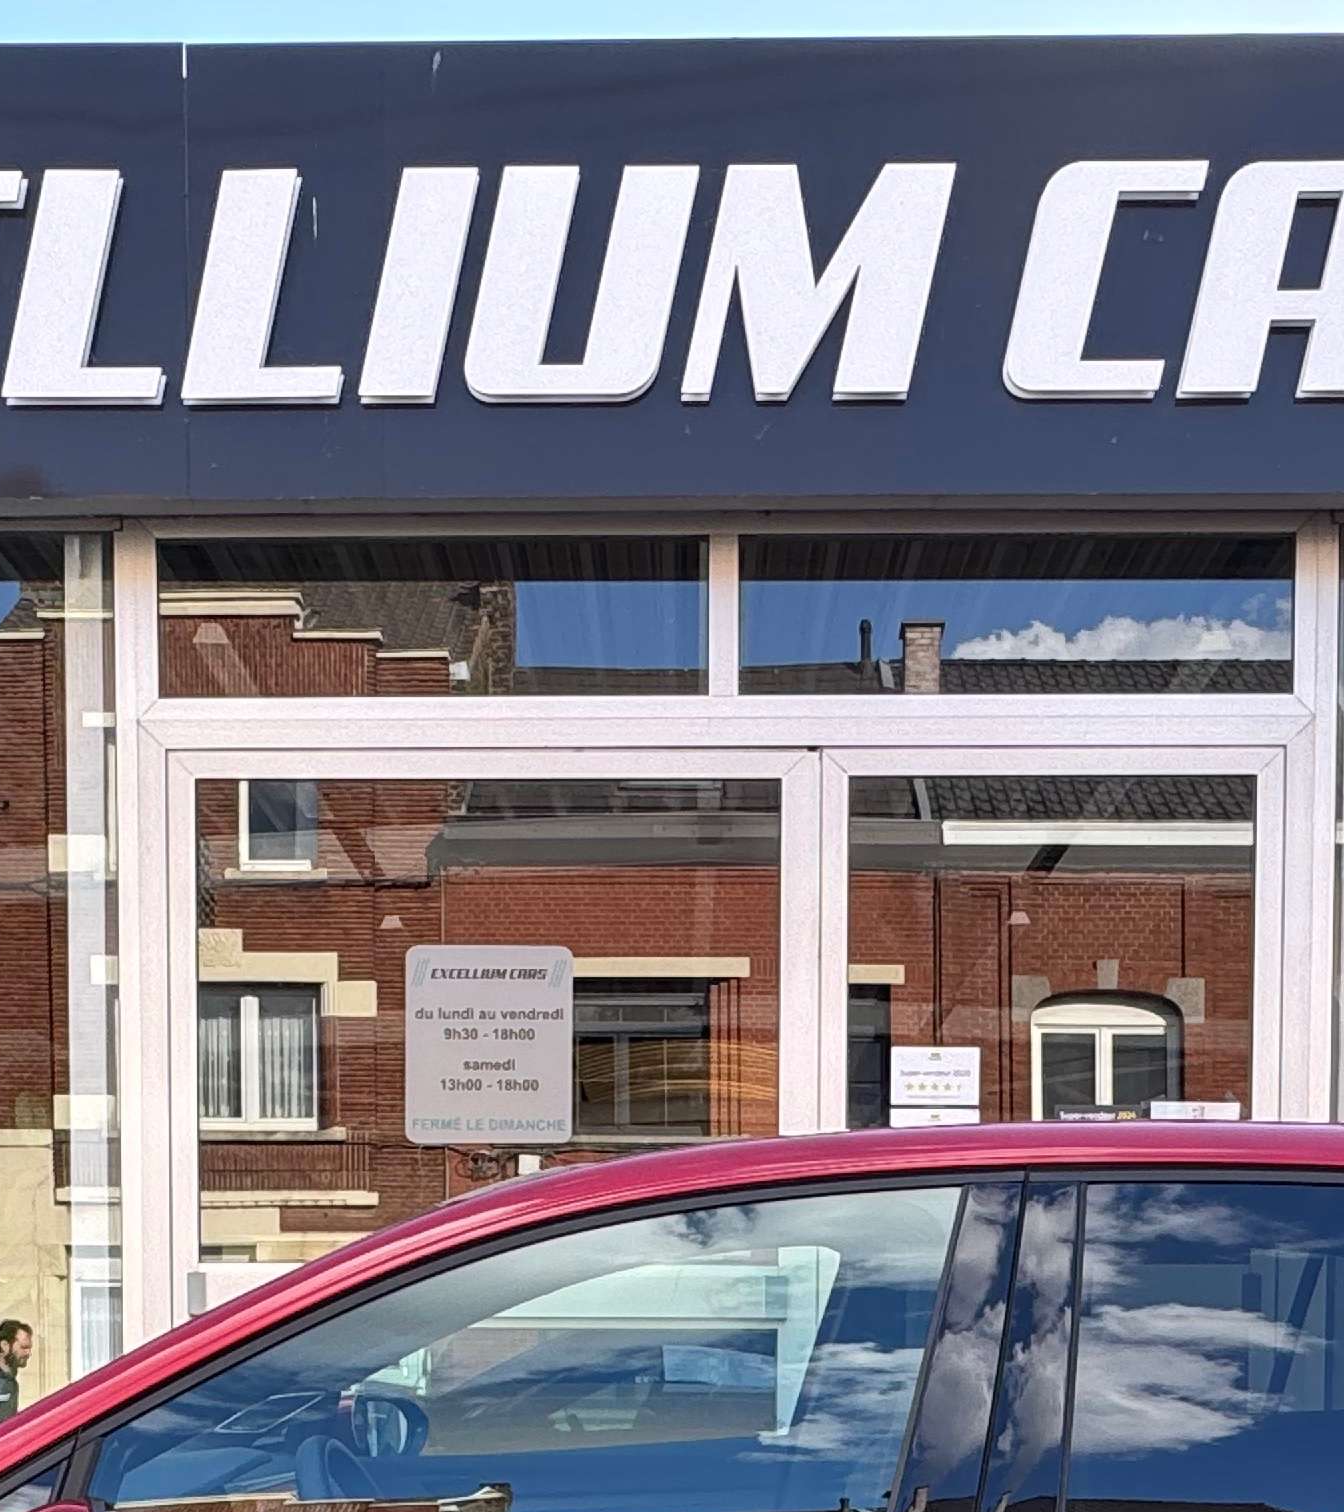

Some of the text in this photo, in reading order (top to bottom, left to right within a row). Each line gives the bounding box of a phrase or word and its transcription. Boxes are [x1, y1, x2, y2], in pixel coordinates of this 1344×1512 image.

[430, 967, 548, 980] EXCELLIUM CARS
[414, 1008, 564, 1020] du lundi au vendredi
[443, 1028, 478, 1040] 9h30
[492, 1028, 536, 1040] 18h00
[463, 1059, 516, 1071] samedi
[440, 1079, 482, 1091] 13h00
[496, 1079, 540, 1091] 18h00
[466, 1119, 485, 1131] LE
[488, 1119, 566, 1131] DIMANCHE
